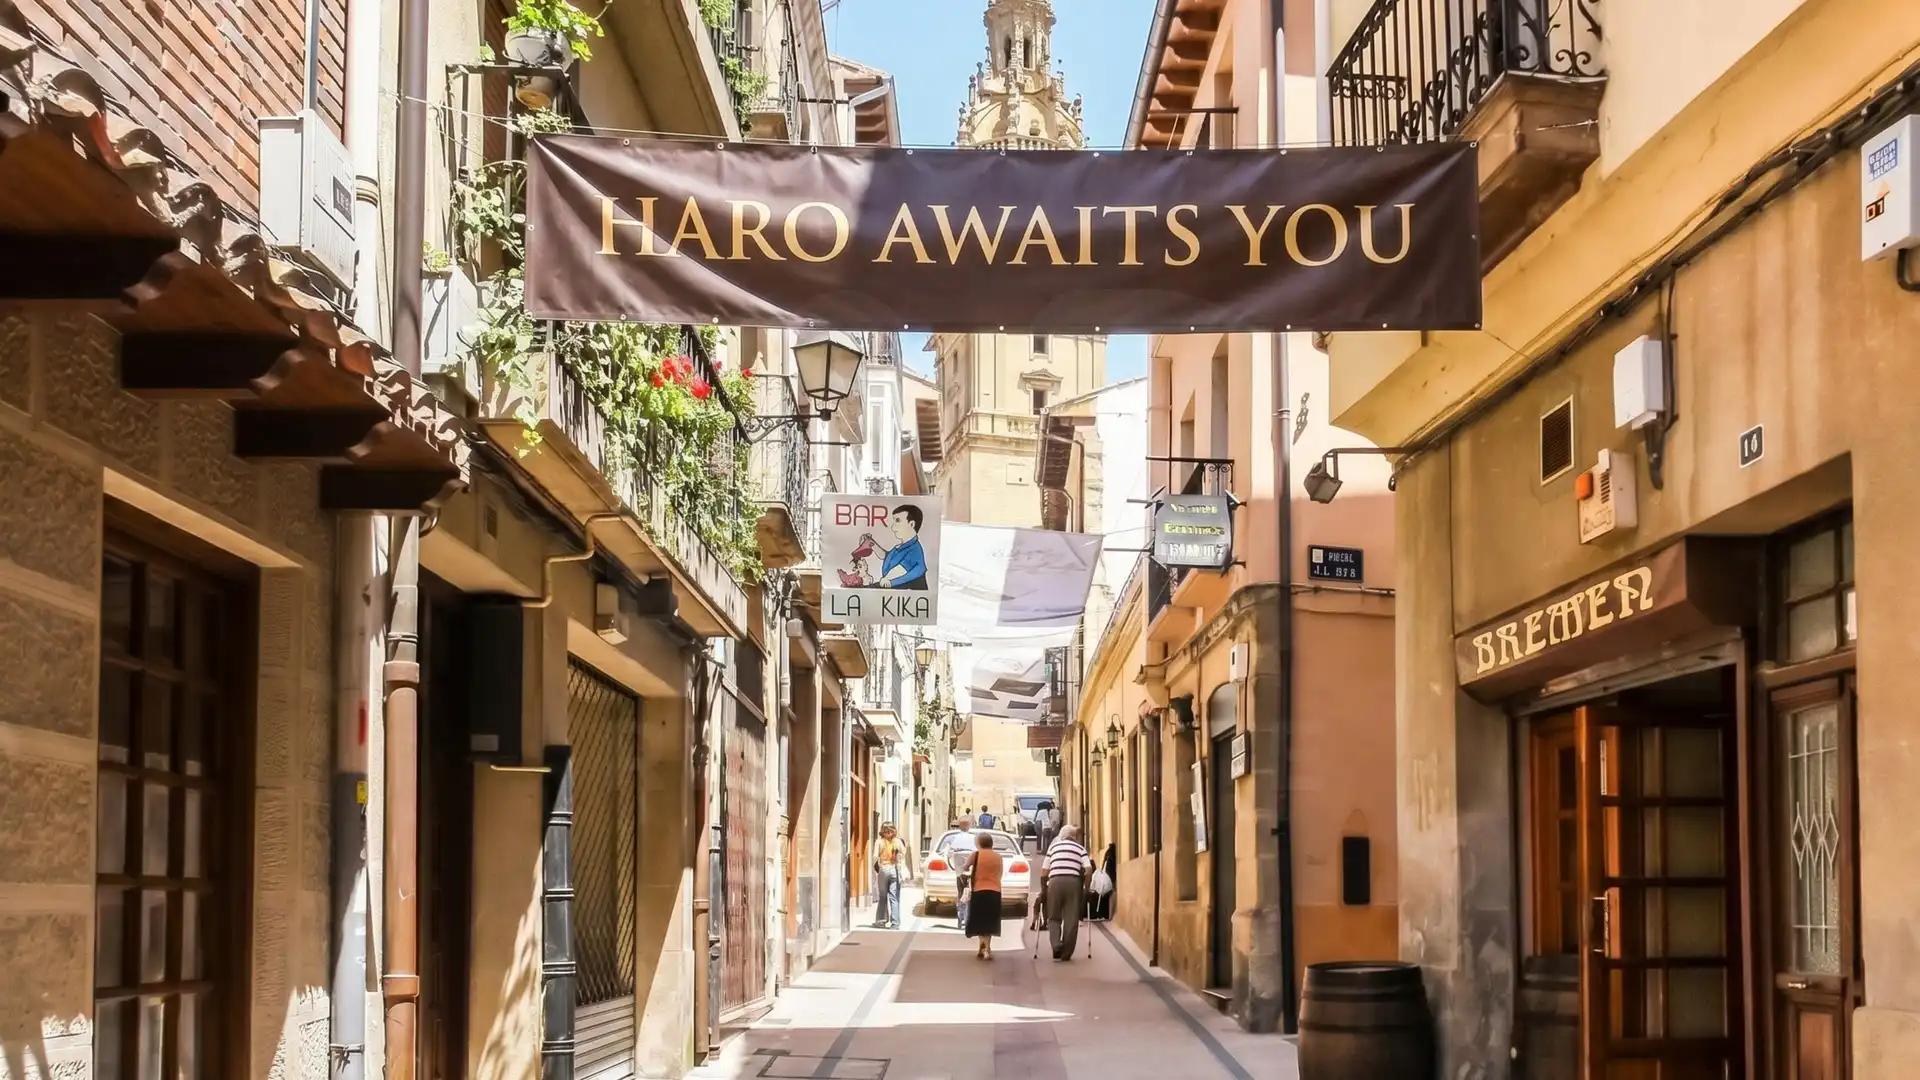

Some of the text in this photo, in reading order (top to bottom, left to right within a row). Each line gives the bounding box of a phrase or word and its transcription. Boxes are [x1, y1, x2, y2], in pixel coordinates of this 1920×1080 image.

[594, 194, 1415, 267] HARO AWAITS YOU
[835, 503, 888, 528] BAR
[831, 594, 929, 618] LA KIKA
[1472, 566, 1654, 675] BREMEN
